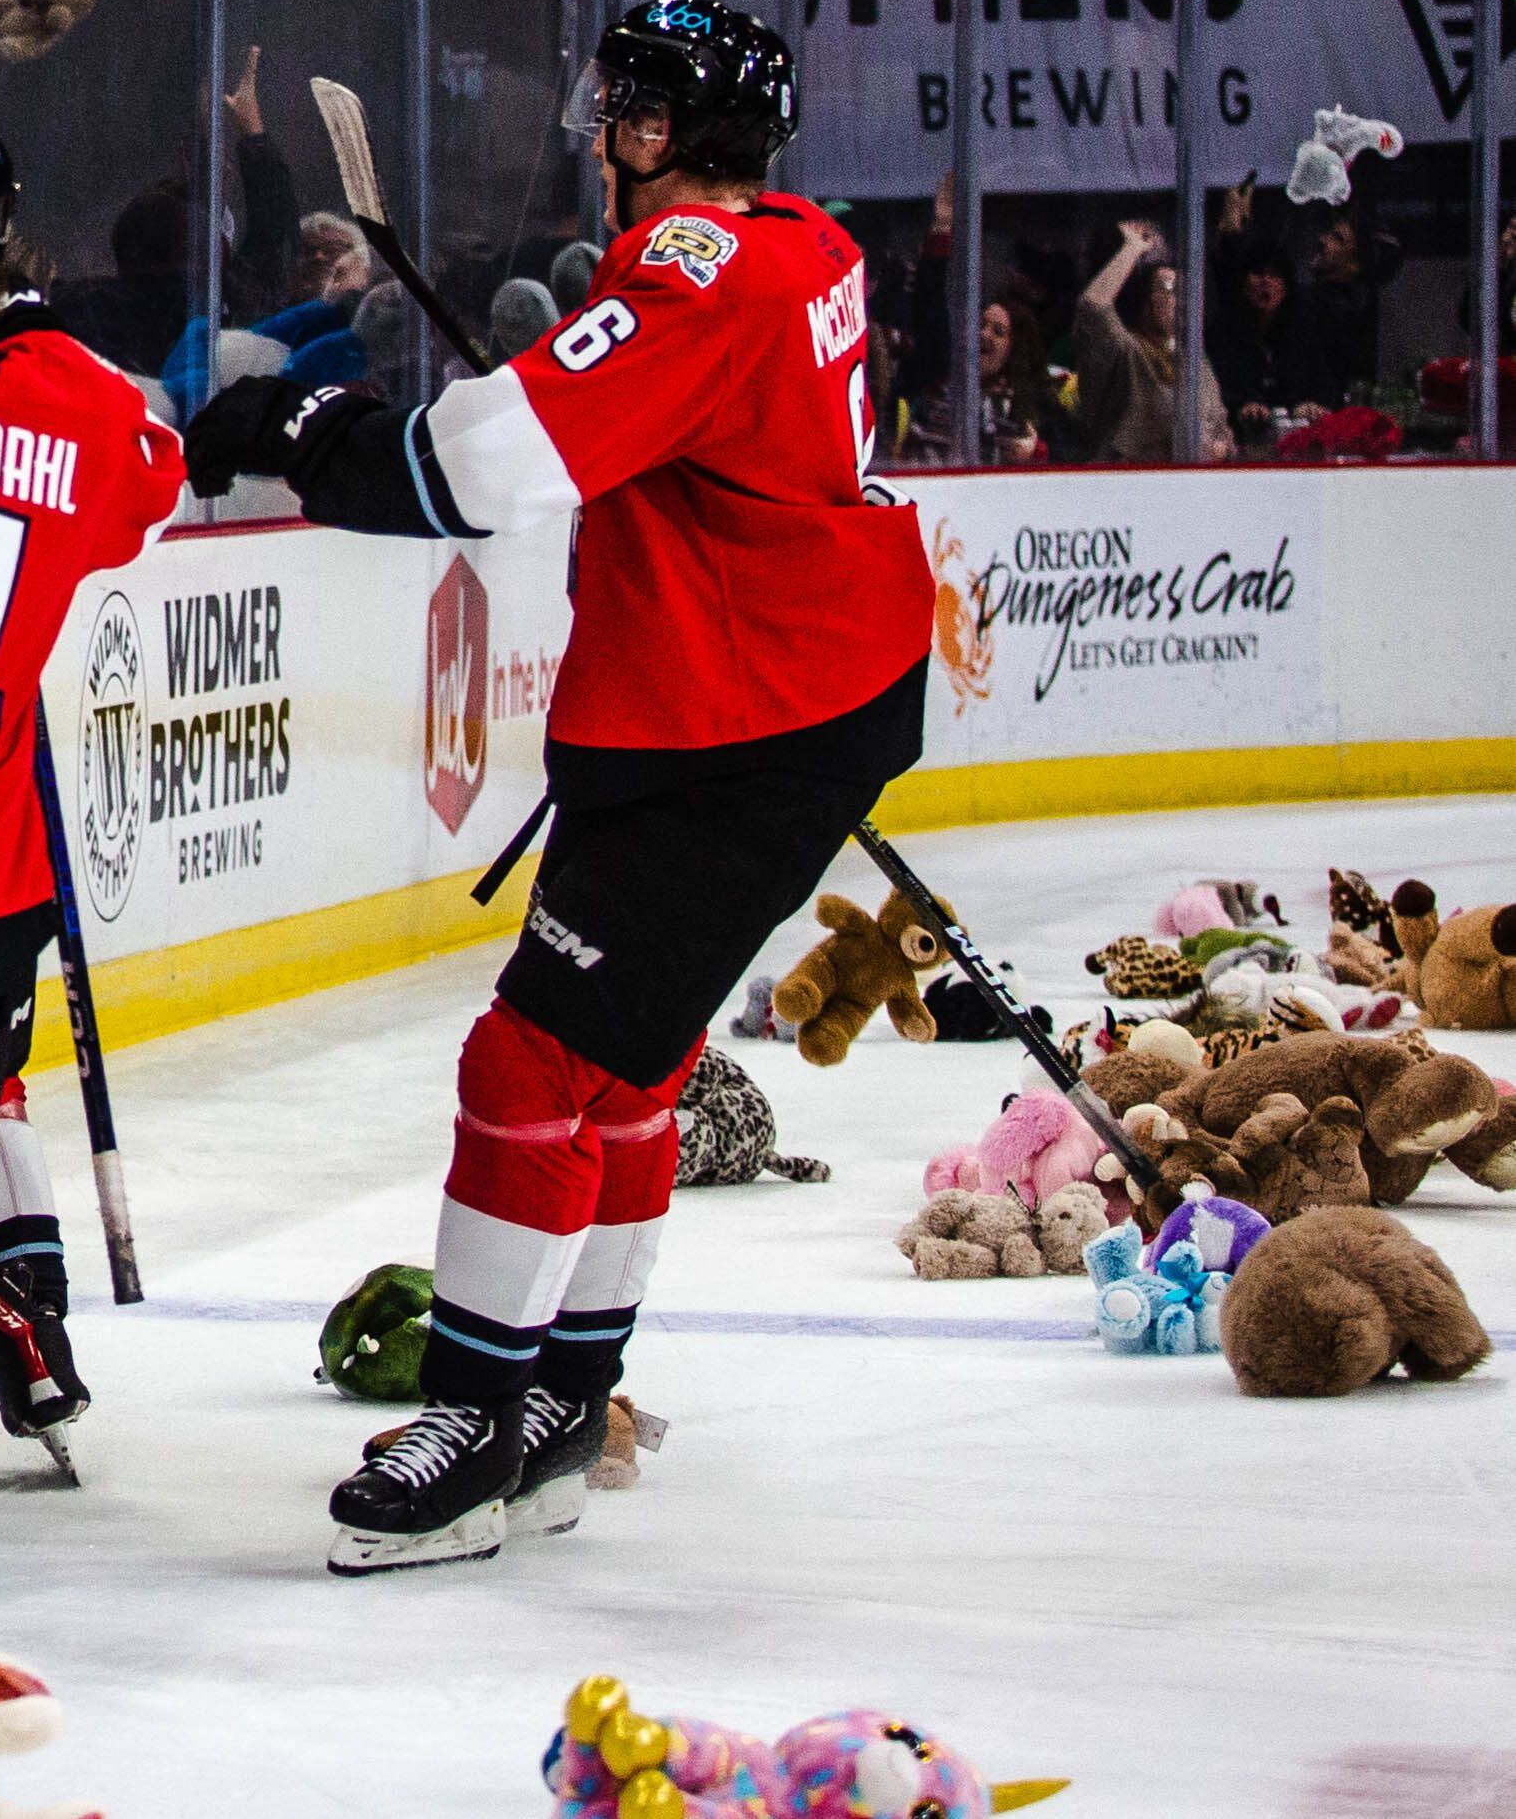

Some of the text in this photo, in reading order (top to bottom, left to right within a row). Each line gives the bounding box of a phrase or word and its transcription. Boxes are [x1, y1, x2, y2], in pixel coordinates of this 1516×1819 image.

[550, 295, 641, 375] 6
[1015, 525, 1132, 573] OREGON
[88, 613, 138, 699] WIDMER
[164, 586, 282, 699] WIDMER
[968, 536, 1297, 702] Dungeness Crab
[1120, 636, 1158, 668] GET
[148, 696, 291, 824] BROTHERS
[84, 794, 139, 899] BROTHERS
[178, 819, 264, 885] BREWING
